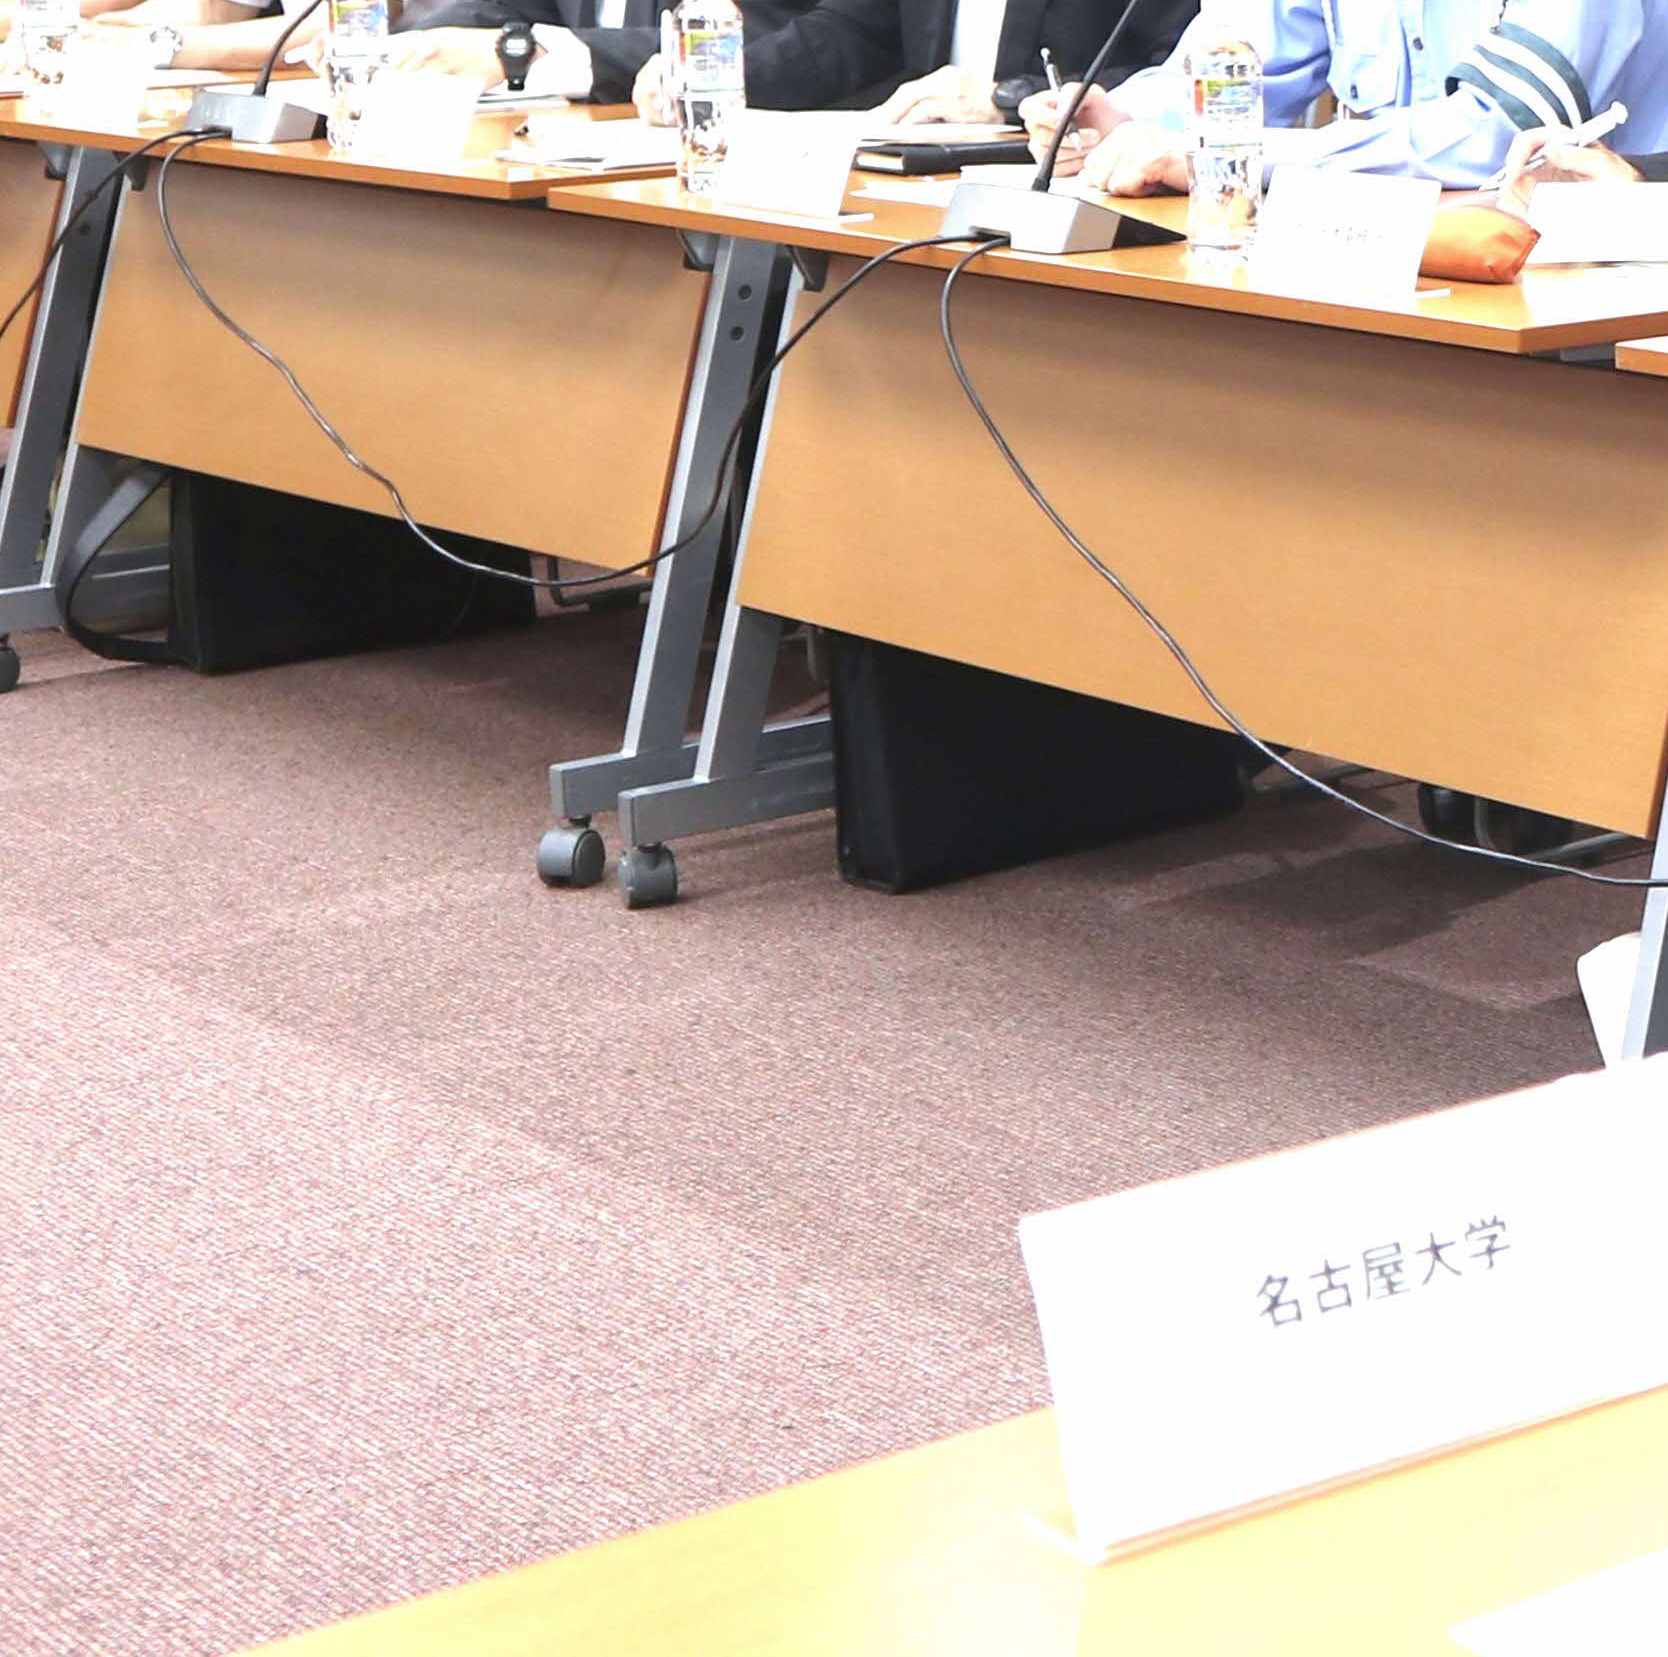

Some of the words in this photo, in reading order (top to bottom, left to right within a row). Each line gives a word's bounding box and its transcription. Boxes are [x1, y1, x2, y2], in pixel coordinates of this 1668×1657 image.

[1256, 1215, 1511, 1326] 名古屋大学
